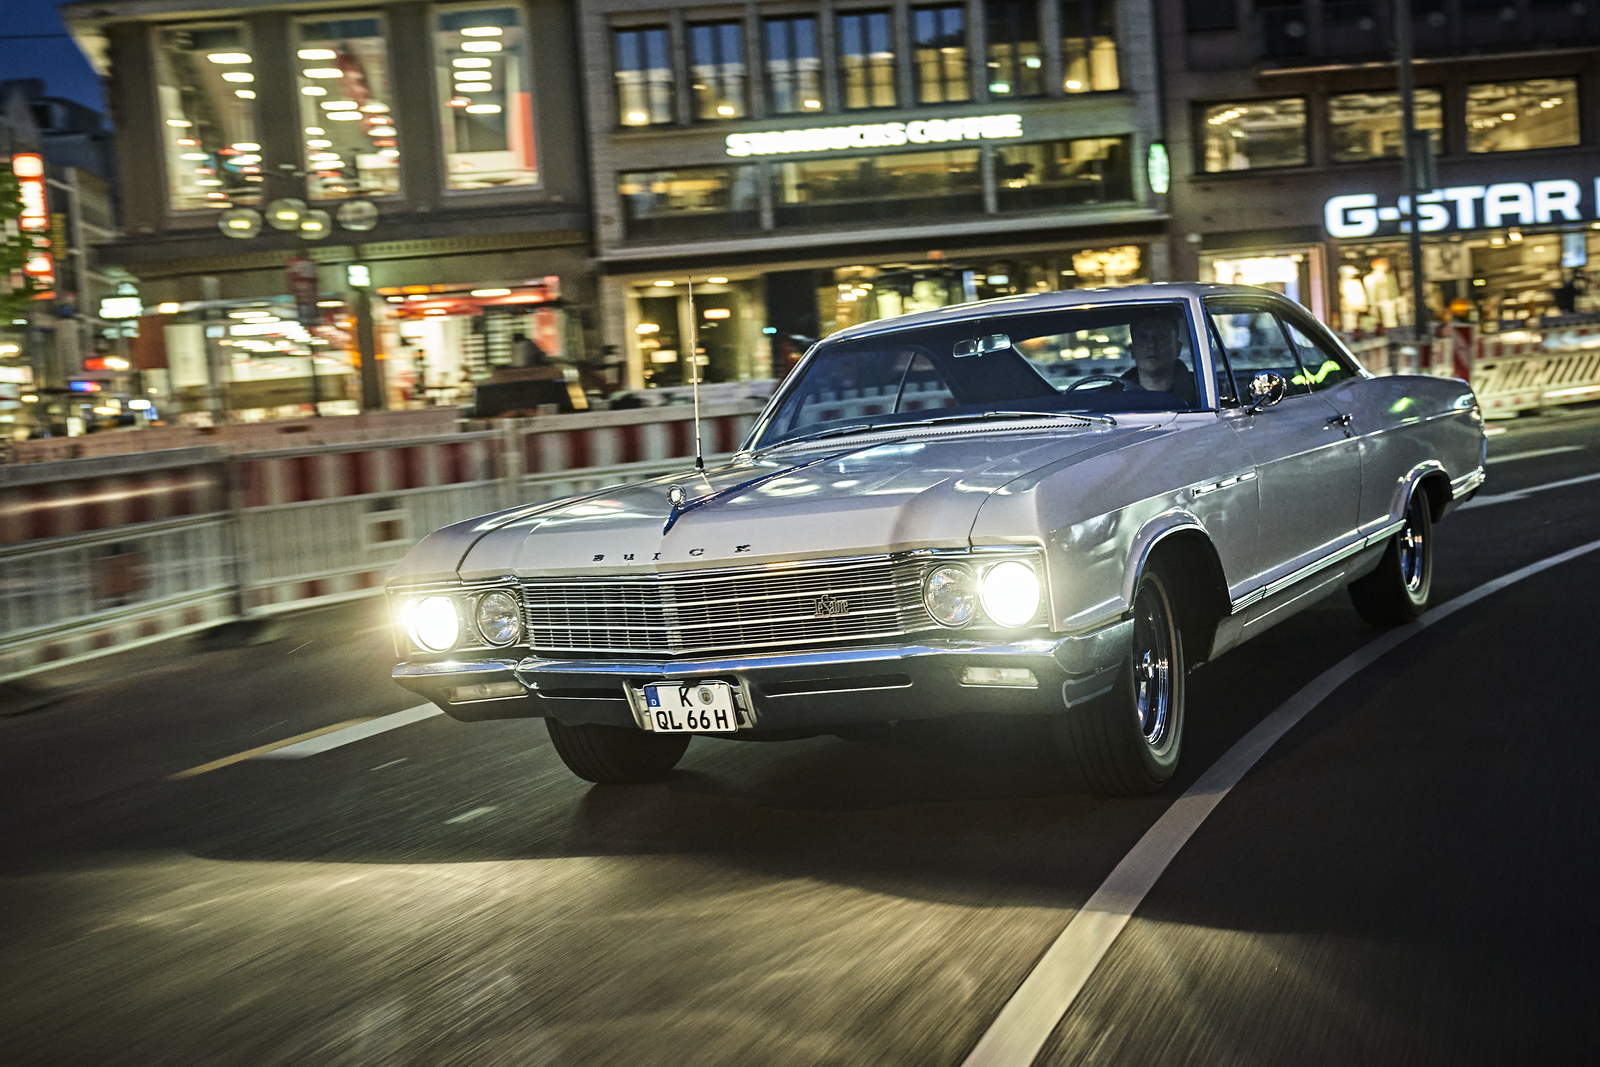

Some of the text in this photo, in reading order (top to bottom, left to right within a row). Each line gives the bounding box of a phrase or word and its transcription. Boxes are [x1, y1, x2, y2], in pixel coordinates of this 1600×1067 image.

[1324, 179, 1582, 238] G-STAR
[678, 686, 693, 707] K
[656, 710, 683, 730] QL
